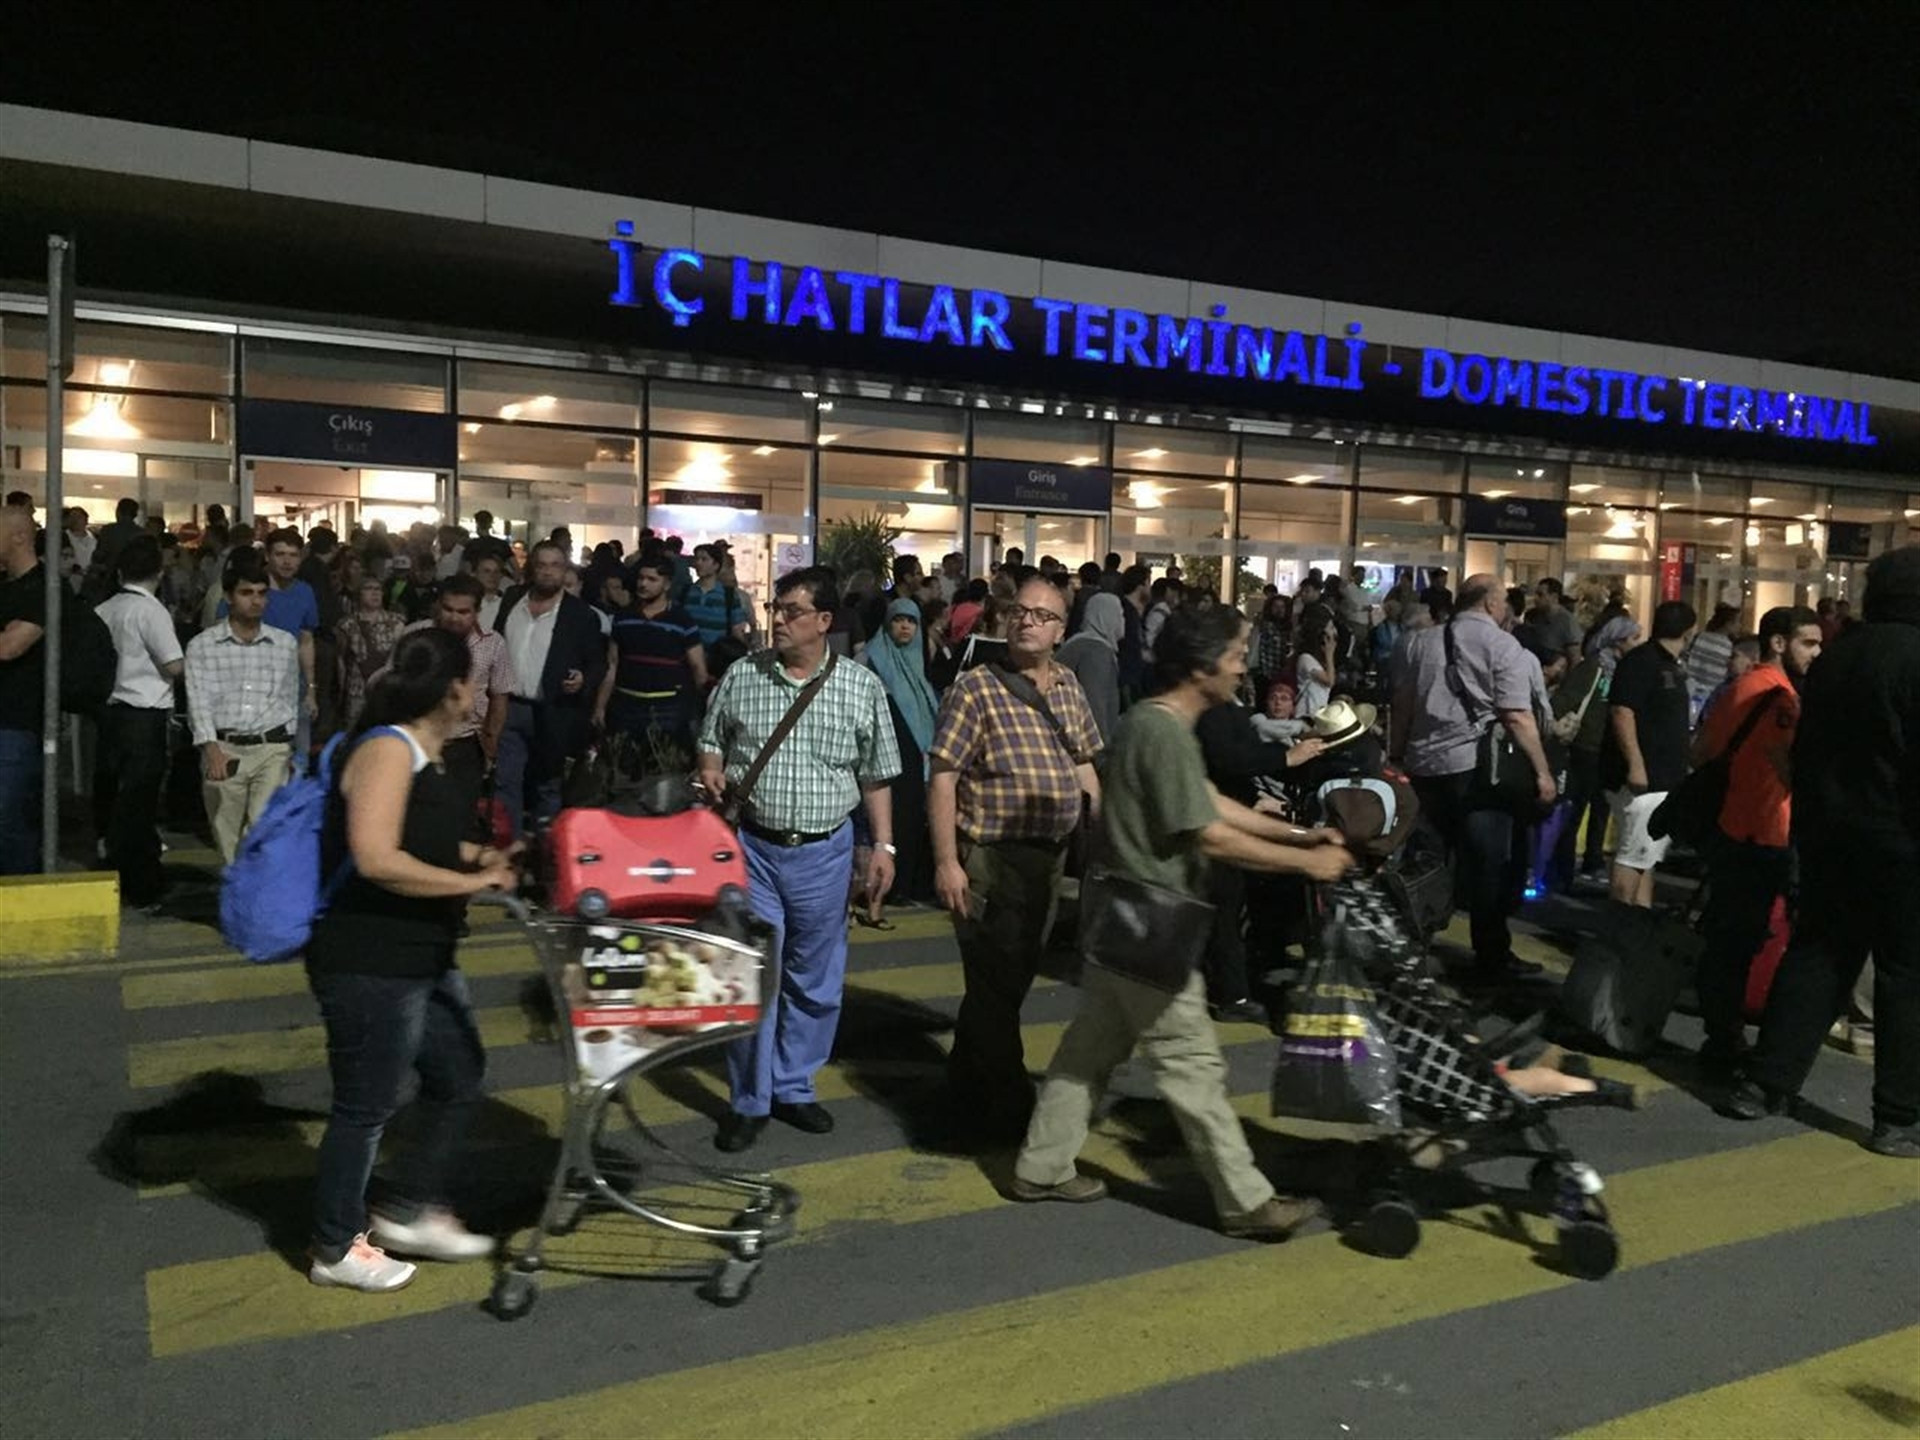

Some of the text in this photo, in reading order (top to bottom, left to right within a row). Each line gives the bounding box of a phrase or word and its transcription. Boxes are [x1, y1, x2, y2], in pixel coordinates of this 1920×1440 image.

[608, 220, 704, 327] İÇ
[731, 255, 1014, 351] HATLAR
[1033, 295, 1367, 391] TERMİNALİ
[1420, 347, 1669, 423] DOMESTIC
[1679, 377, 1878, 446] TERMINAL
[328, 413, 373, 437] Çıkış
[1028, 469, 1057, 486] Giriş
